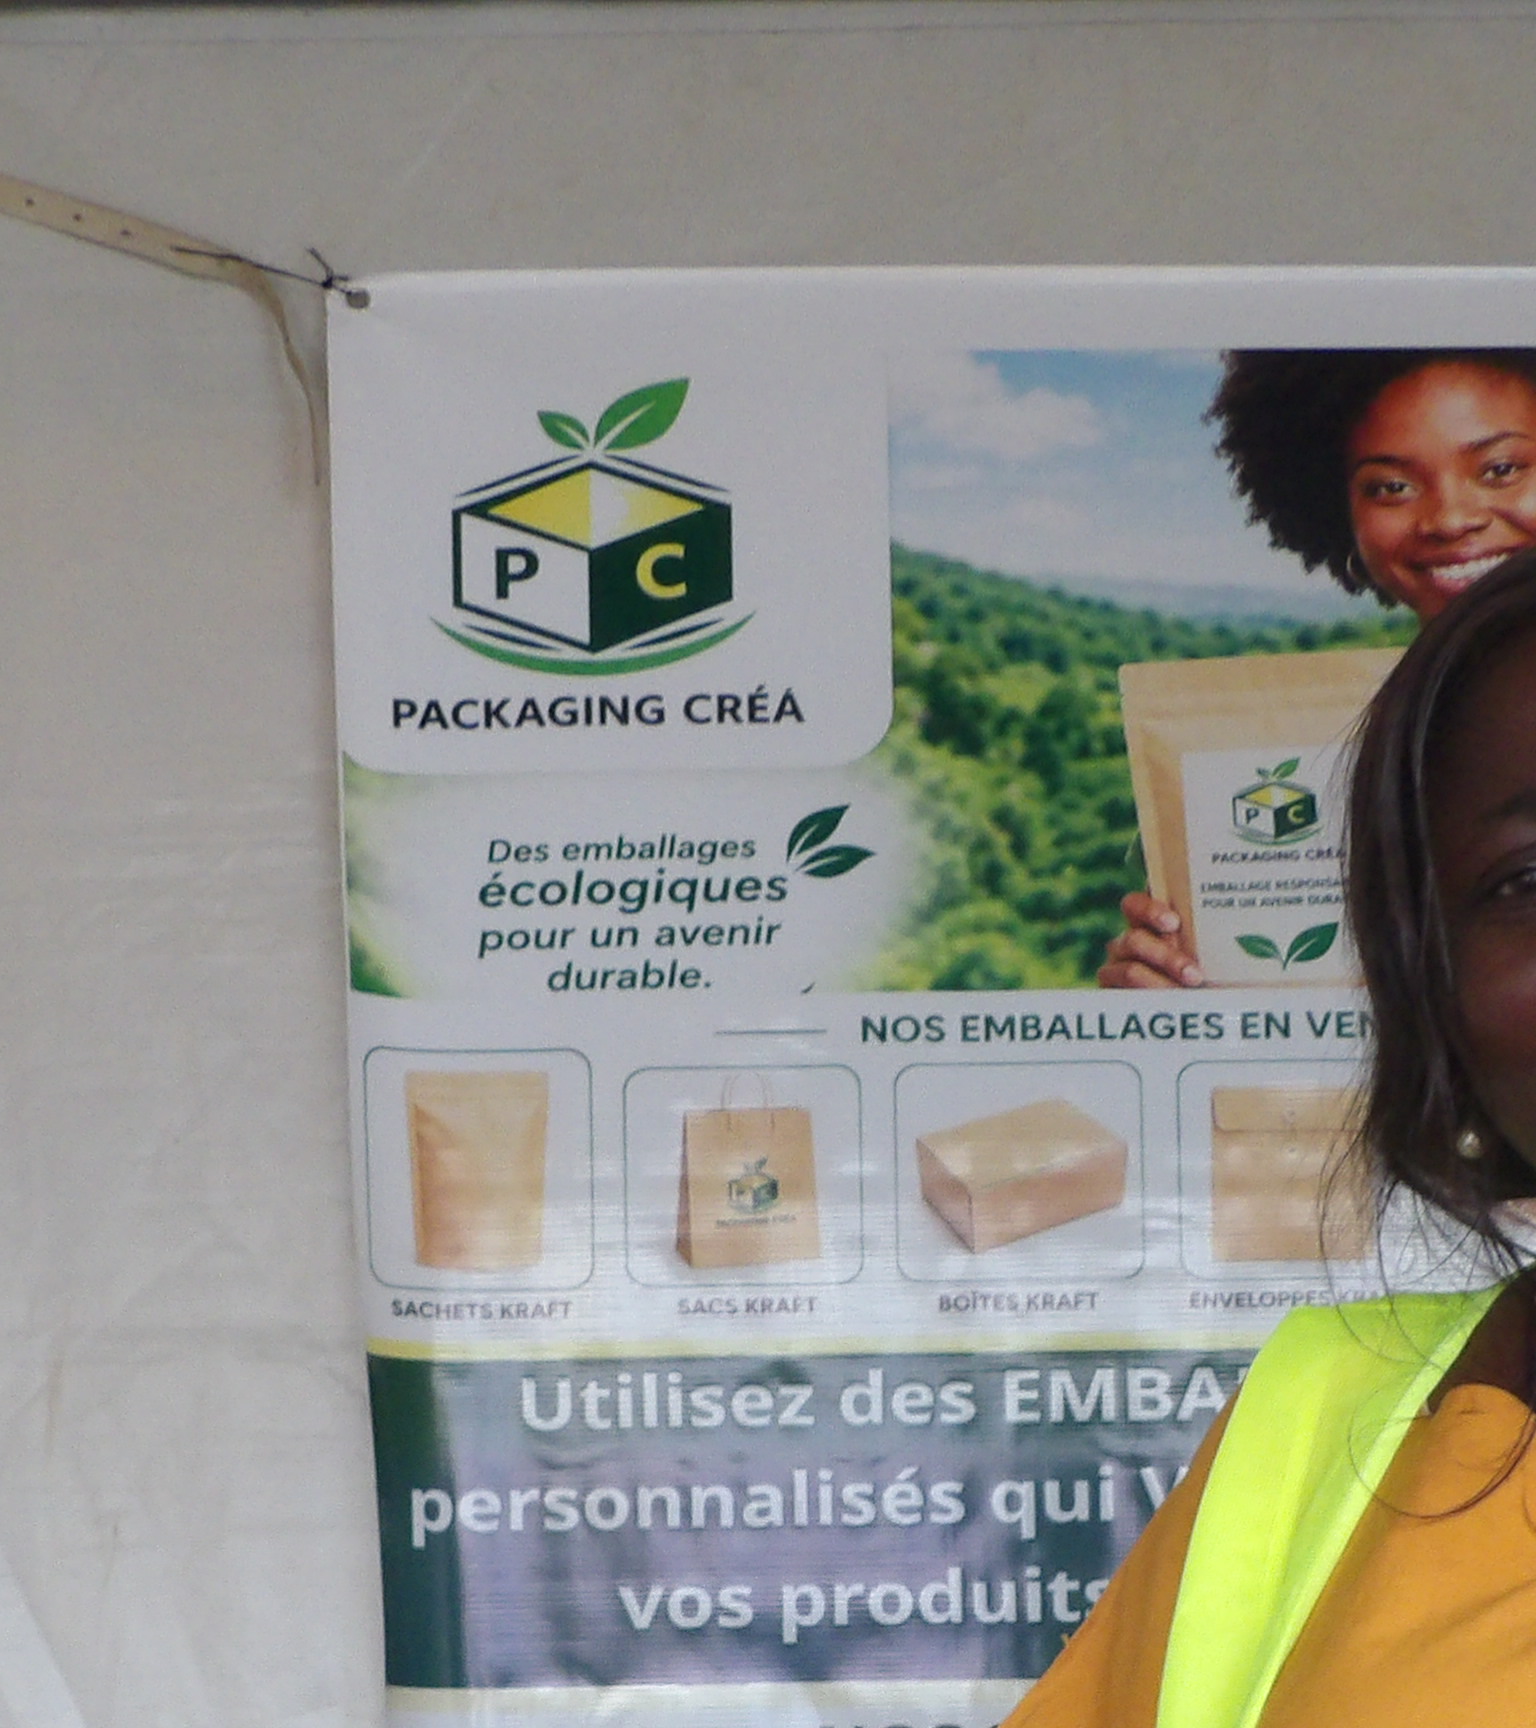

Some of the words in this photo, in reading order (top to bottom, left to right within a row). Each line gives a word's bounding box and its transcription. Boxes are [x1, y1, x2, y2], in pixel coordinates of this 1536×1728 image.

[494, 547, 540, 600] P
[636, 543, 688, 599] C
[391, 694, 666, 730] PACKAGING
[487, 839, 549, 864] Des
[562, 834, 757, 865] emballages
[1212, 849, 1301, 864] PACKAGING
[477, 869, 788, 914] écologiques
[477, 925, 575, 959] pour
[589, 923, 639, 948] un
[654, 915, 783, 948] avenir
[547, 960, 713, 993] durable.
[860, 1014, 946, 1043] NOS
[960, 1011, 1224, 1042] EMBALLAGES
[1240, 1010, 1291, 1040] EN
[390, 1299, 494, 1321] SACHETS
[499, 1300, 574, 1320] KRAFT
[677, 1297, 738, 1317] SACS
[744, 1295, 819, 1316] KRAFT
[1025, 1290, 1101, 1312] KRAFT
[1189, 1288, 1332, 1309] ENVELOPPES
[520, 1371, 816, 1432] Utilisez
[838, 1367, 978, 1426] des
[1003, 1365, 1248, 1425] EMBA
[410, 1465, 967, 1550] personnalisés
[990, 1463, 1115, 1541] qui
[617, 1581, 755, 1631] vos
